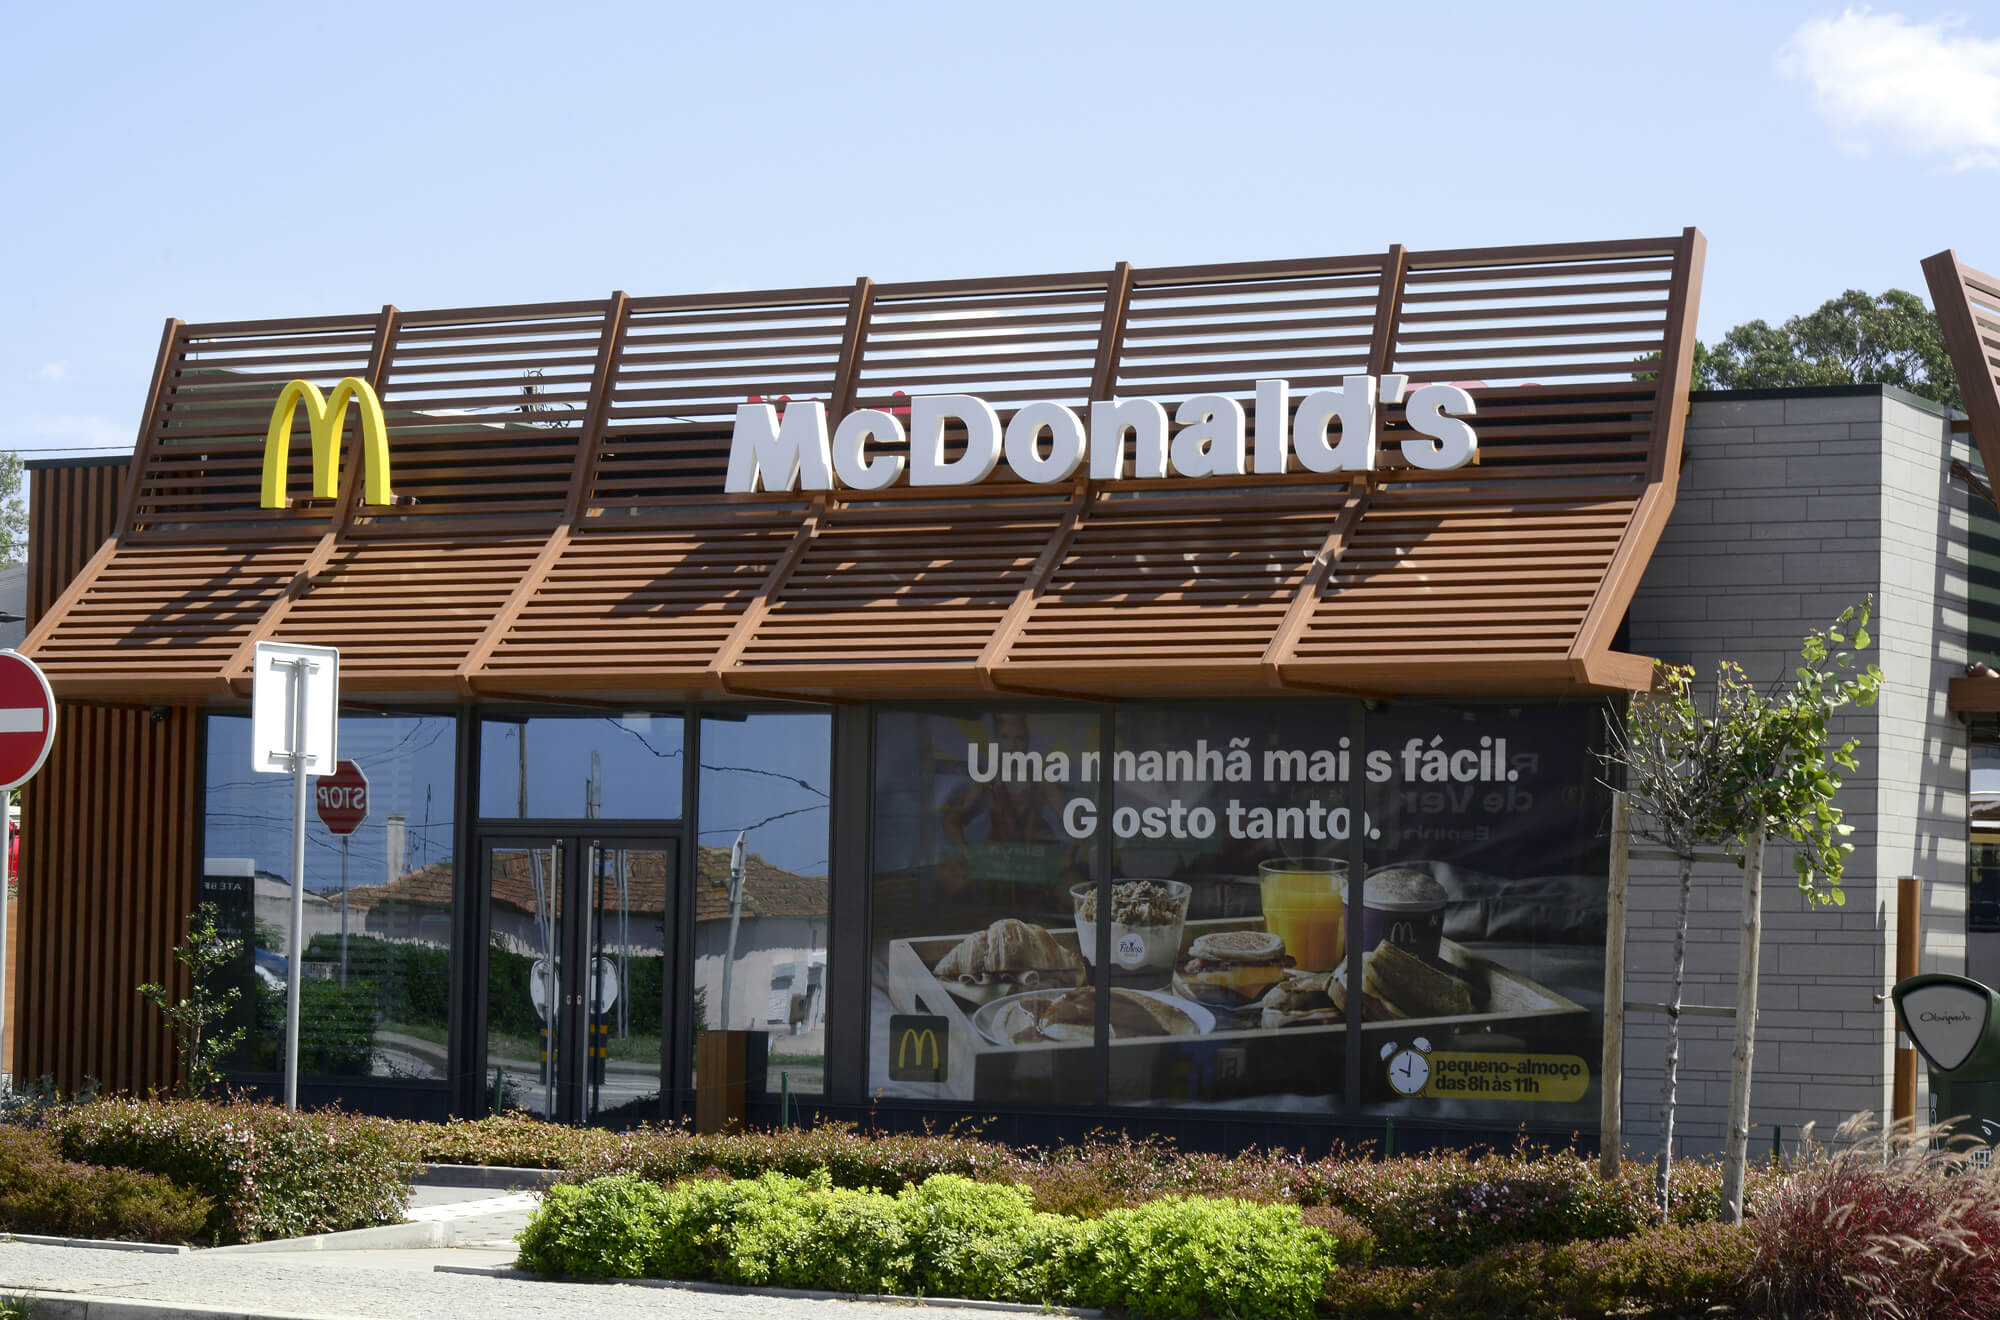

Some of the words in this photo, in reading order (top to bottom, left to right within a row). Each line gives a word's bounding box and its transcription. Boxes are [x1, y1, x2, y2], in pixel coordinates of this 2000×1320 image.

[724, 374, 1479, 494] McDonald's
[967, 742, 1070, 783] Uma
[1081, 736, 1252, 783] manhã
[1263, 736, 1393, 783] mais
[1400, 734, 1519, 783] fácil.
[1062, 796, 1217, 839] Gosto
[1225, 799, 1381, 840] tanto.
[1435, 1058, 1581, 1080] pequeno-almoço
[1435, 1075, 1466, 1091] das
[1467, 1075, 1490, 1091] 8h
[1493, 1075, 1512, 1092] às
[1516, 1077, 1540, 1093] 11h
